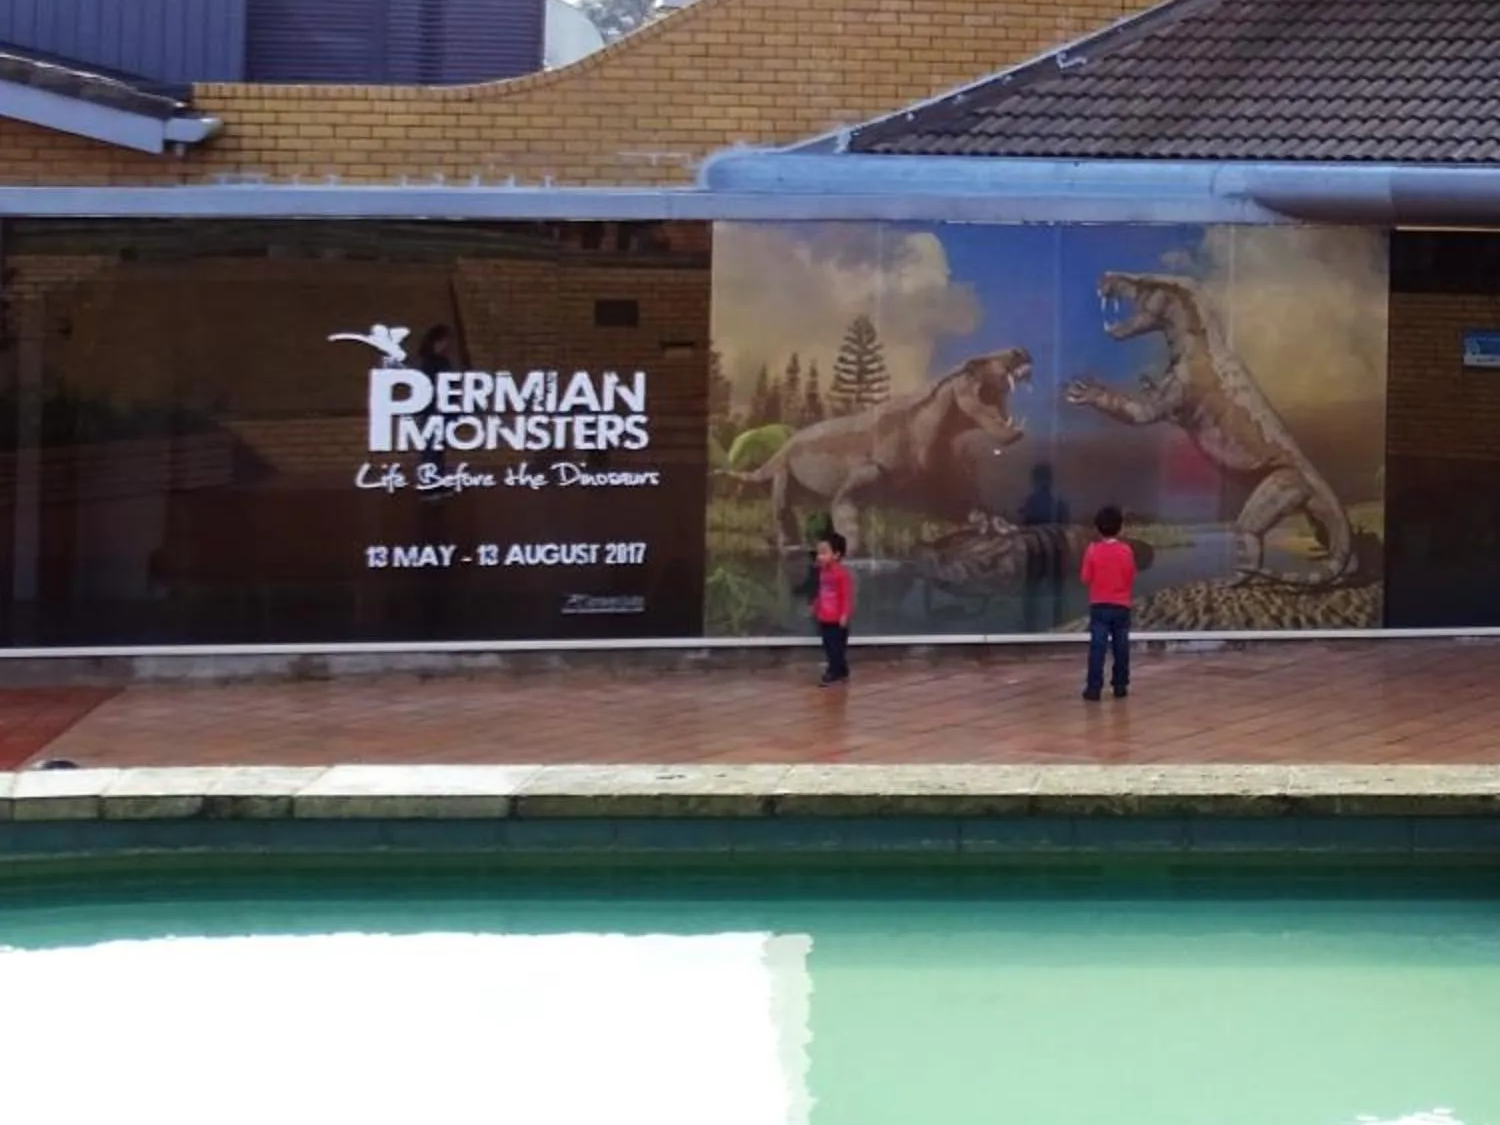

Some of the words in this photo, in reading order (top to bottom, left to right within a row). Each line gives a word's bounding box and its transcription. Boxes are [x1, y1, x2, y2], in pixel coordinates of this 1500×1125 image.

[369, 367, 646, 452] PERMIAN
[398, 414, 649, 451] MONSTERS
[355, 462, 408, 494] Life
[415, 462, 497, 493] Before
[504, 463, 549, 490] the
[550, 461, 660, 488] Dinosaurs
[366, 546, 388, 568] 13
[392, 545, 457, 568] MAY
[476, 545, 499, 566] 13
[504, 543, 600, 566] AUGUST
[605, 542, 647, 565] 2017
